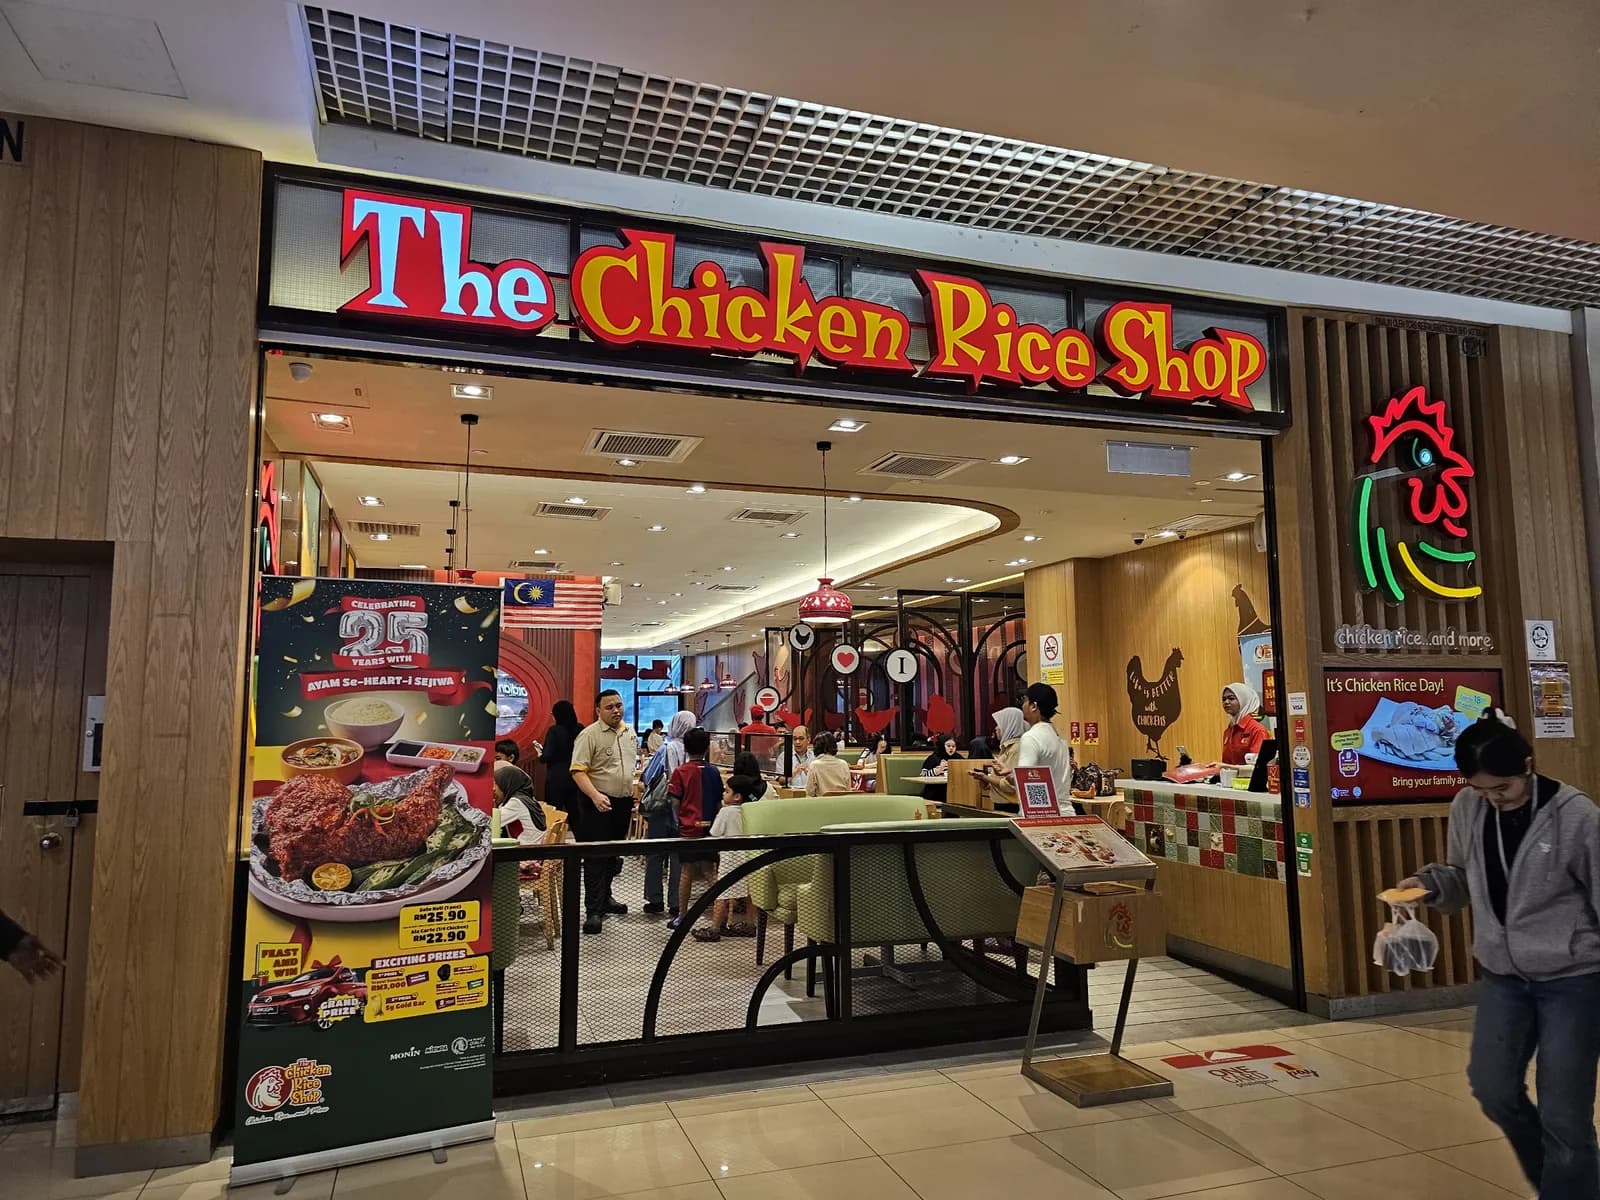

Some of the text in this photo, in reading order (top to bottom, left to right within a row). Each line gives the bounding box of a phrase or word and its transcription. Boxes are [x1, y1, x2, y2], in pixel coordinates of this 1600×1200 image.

[353, 198, 1261, 398] The Chicken Rice Shop
[351, 600, 417, 609] CELEBRATING
[339, 609, 430, 657] 25
[1338, 628, 1392, 645] chicken
[1459, 635, 1491, 647] more
[352, 655, 412, 667] YEARS WITH
[307, 678, 340, 692] AYAM
[1326, 678, 1444, 695] It's Chicken Rice Day!
[1392, 776, 1414, 788] Bring
[1414, 778, 1432, 788] your
[1433, 775, 1456, 787] family
[375, 950, 466, 968] EXCITING PRIZES
[274, 968, 298, 978] WIN
[320, 998, 358, 1010] GRAND
[322, 1006, 356, 1018] PRIZE
[285, 1062, 330, 1079] Chicken
[294, 1078, 320, 1090] Rice
[292, 1090, 320, 1104] Shop
